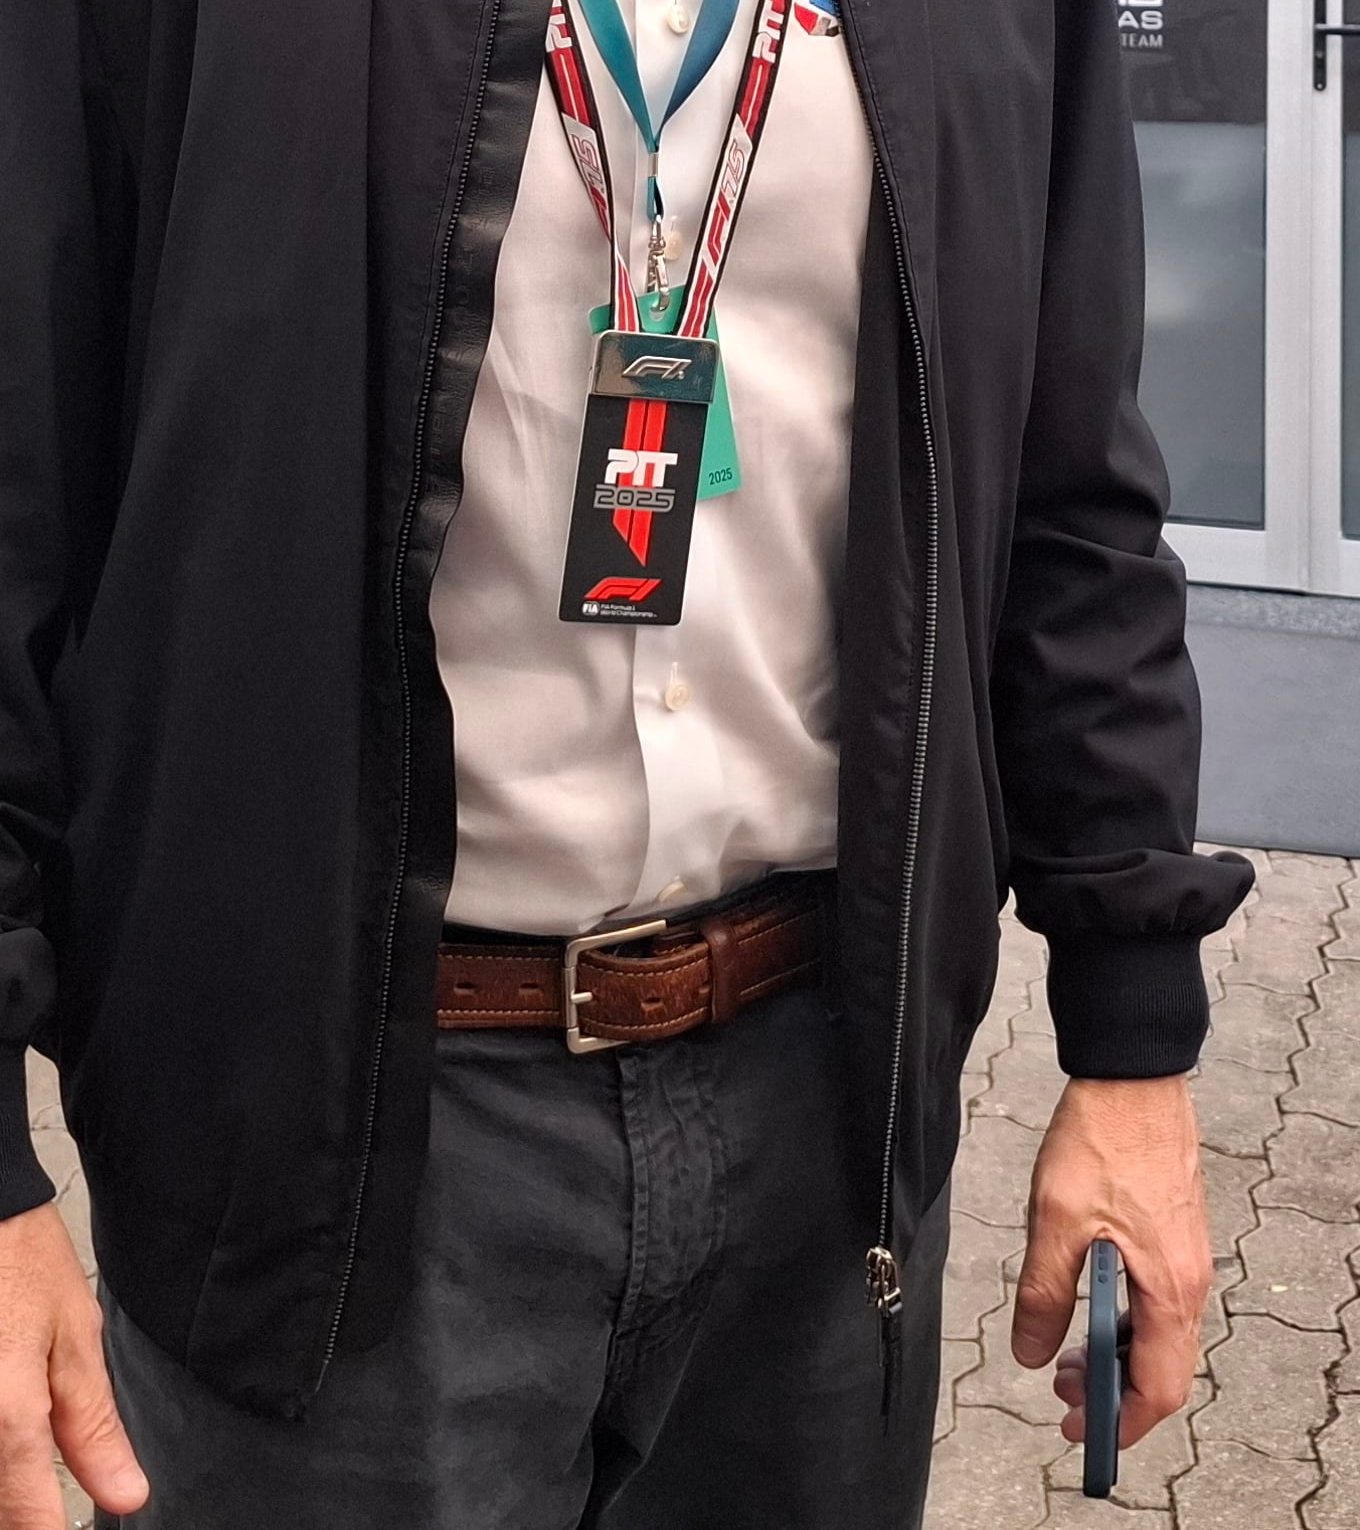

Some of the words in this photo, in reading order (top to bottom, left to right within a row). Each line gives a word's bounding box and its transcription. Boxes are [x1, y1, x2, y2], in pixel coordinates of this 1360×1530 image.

[604, 448, 679, 487] PIT
[708, 467, 733, 485] 2025
[593, 483, 676, 513] 2025
[582, 602, 598, 614] FIA
